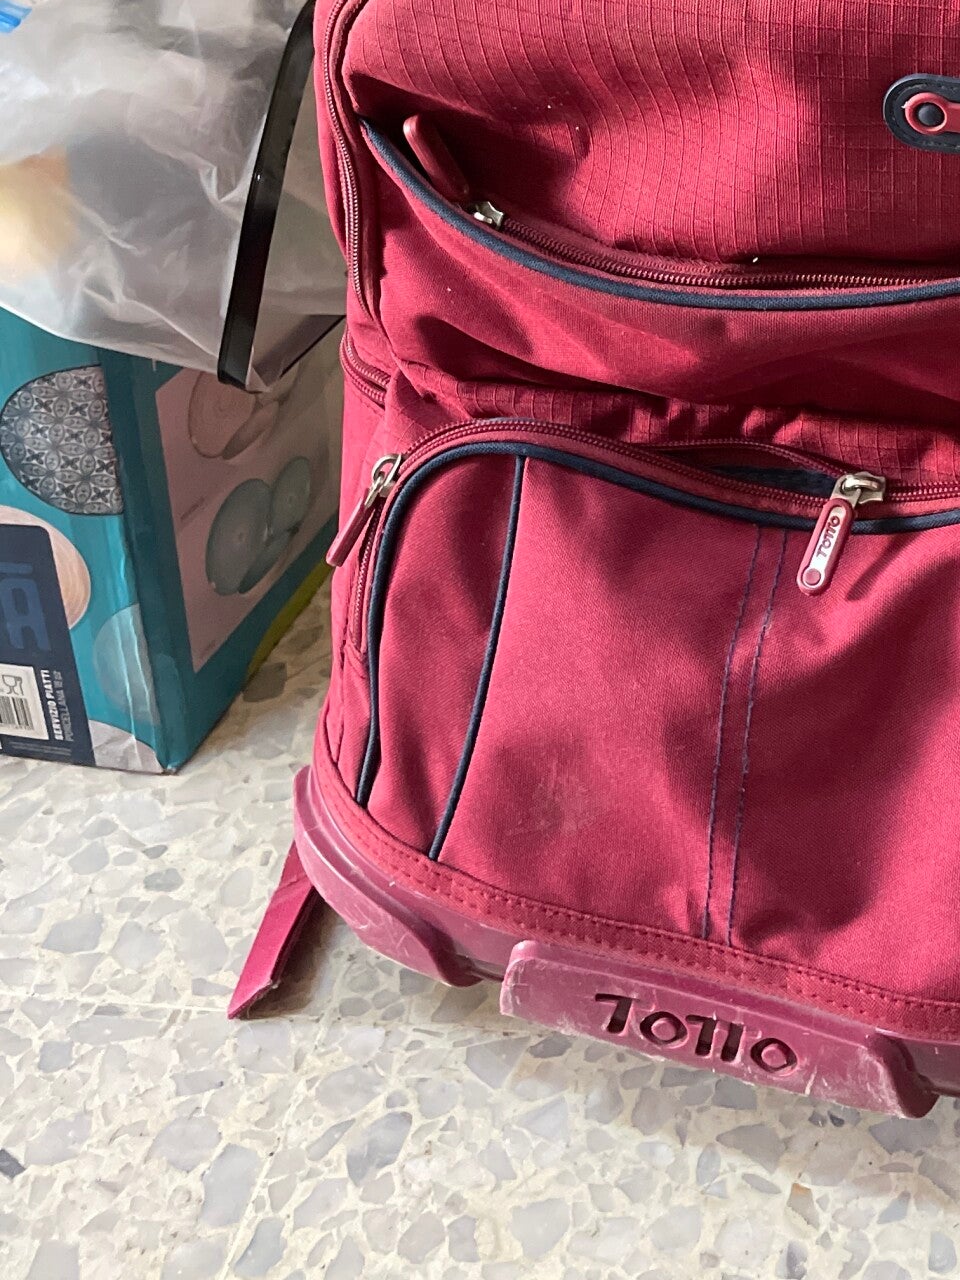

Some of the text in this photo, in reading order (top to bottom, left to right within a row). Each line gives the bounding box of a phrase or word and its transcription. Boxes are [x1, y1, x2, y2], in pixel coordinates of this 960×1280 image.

[815, 515, 840, 558] TOTTO
[40, 669, 64, 741] SERVIZIO PIATTI
[594, 993, 798, 1074] TOTTO
